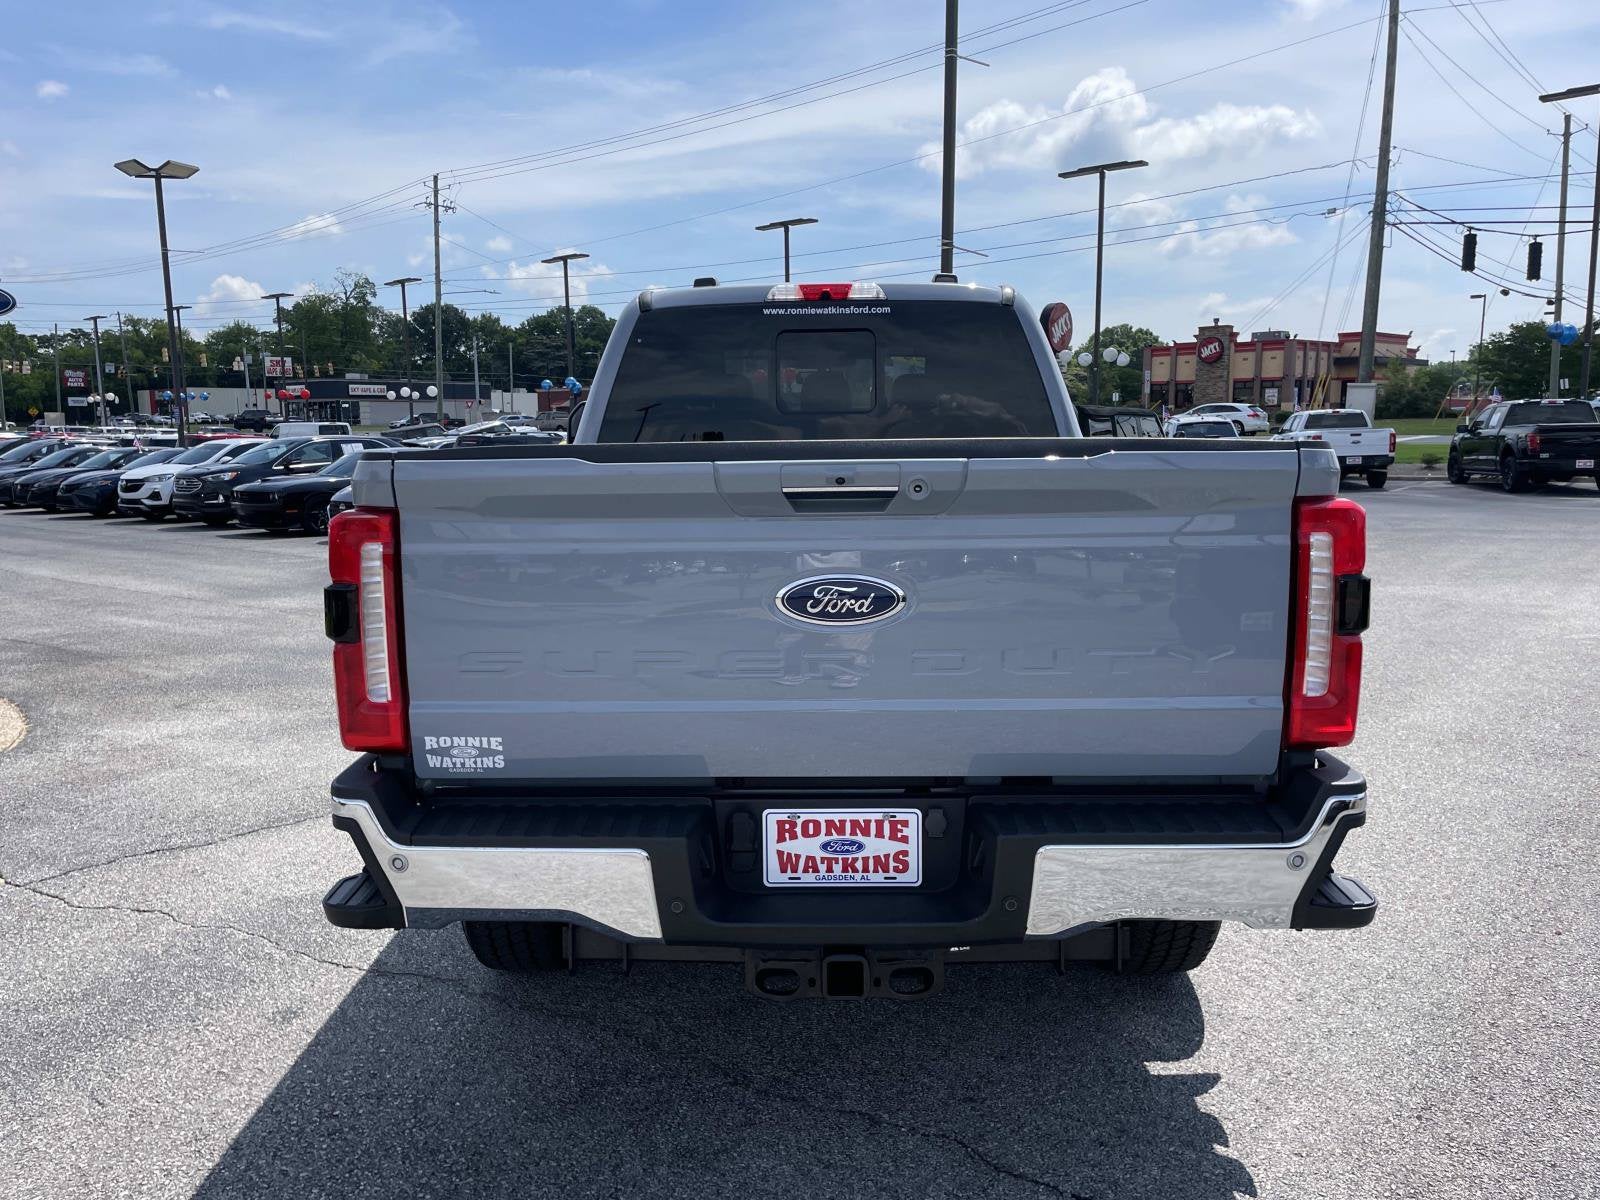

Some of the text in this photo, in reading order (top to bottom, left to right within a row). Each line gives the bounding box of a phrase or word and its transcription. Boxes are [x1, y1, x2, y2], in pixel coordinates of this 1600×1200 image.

[763, 305, 891, 315] www.ronniewatkinsford.com
[1051, 311, 1071, 344] JACK'S
[1201, 341, 1220, 359] JACK'S
[806, 585, 876, 613] Ford
[458, 646, 1238, 680] SUPER DUTY
[424, 736, 503, 751] RONNIE
[425, 753, 505, 769] WATKINS
[776, 819, 910, 845] RONNIE
[827, 841, 859, 852] Ford
[776, 849, 910, 874] WATKINS
[814, 874, 872, 882] GADSDEN, AL
